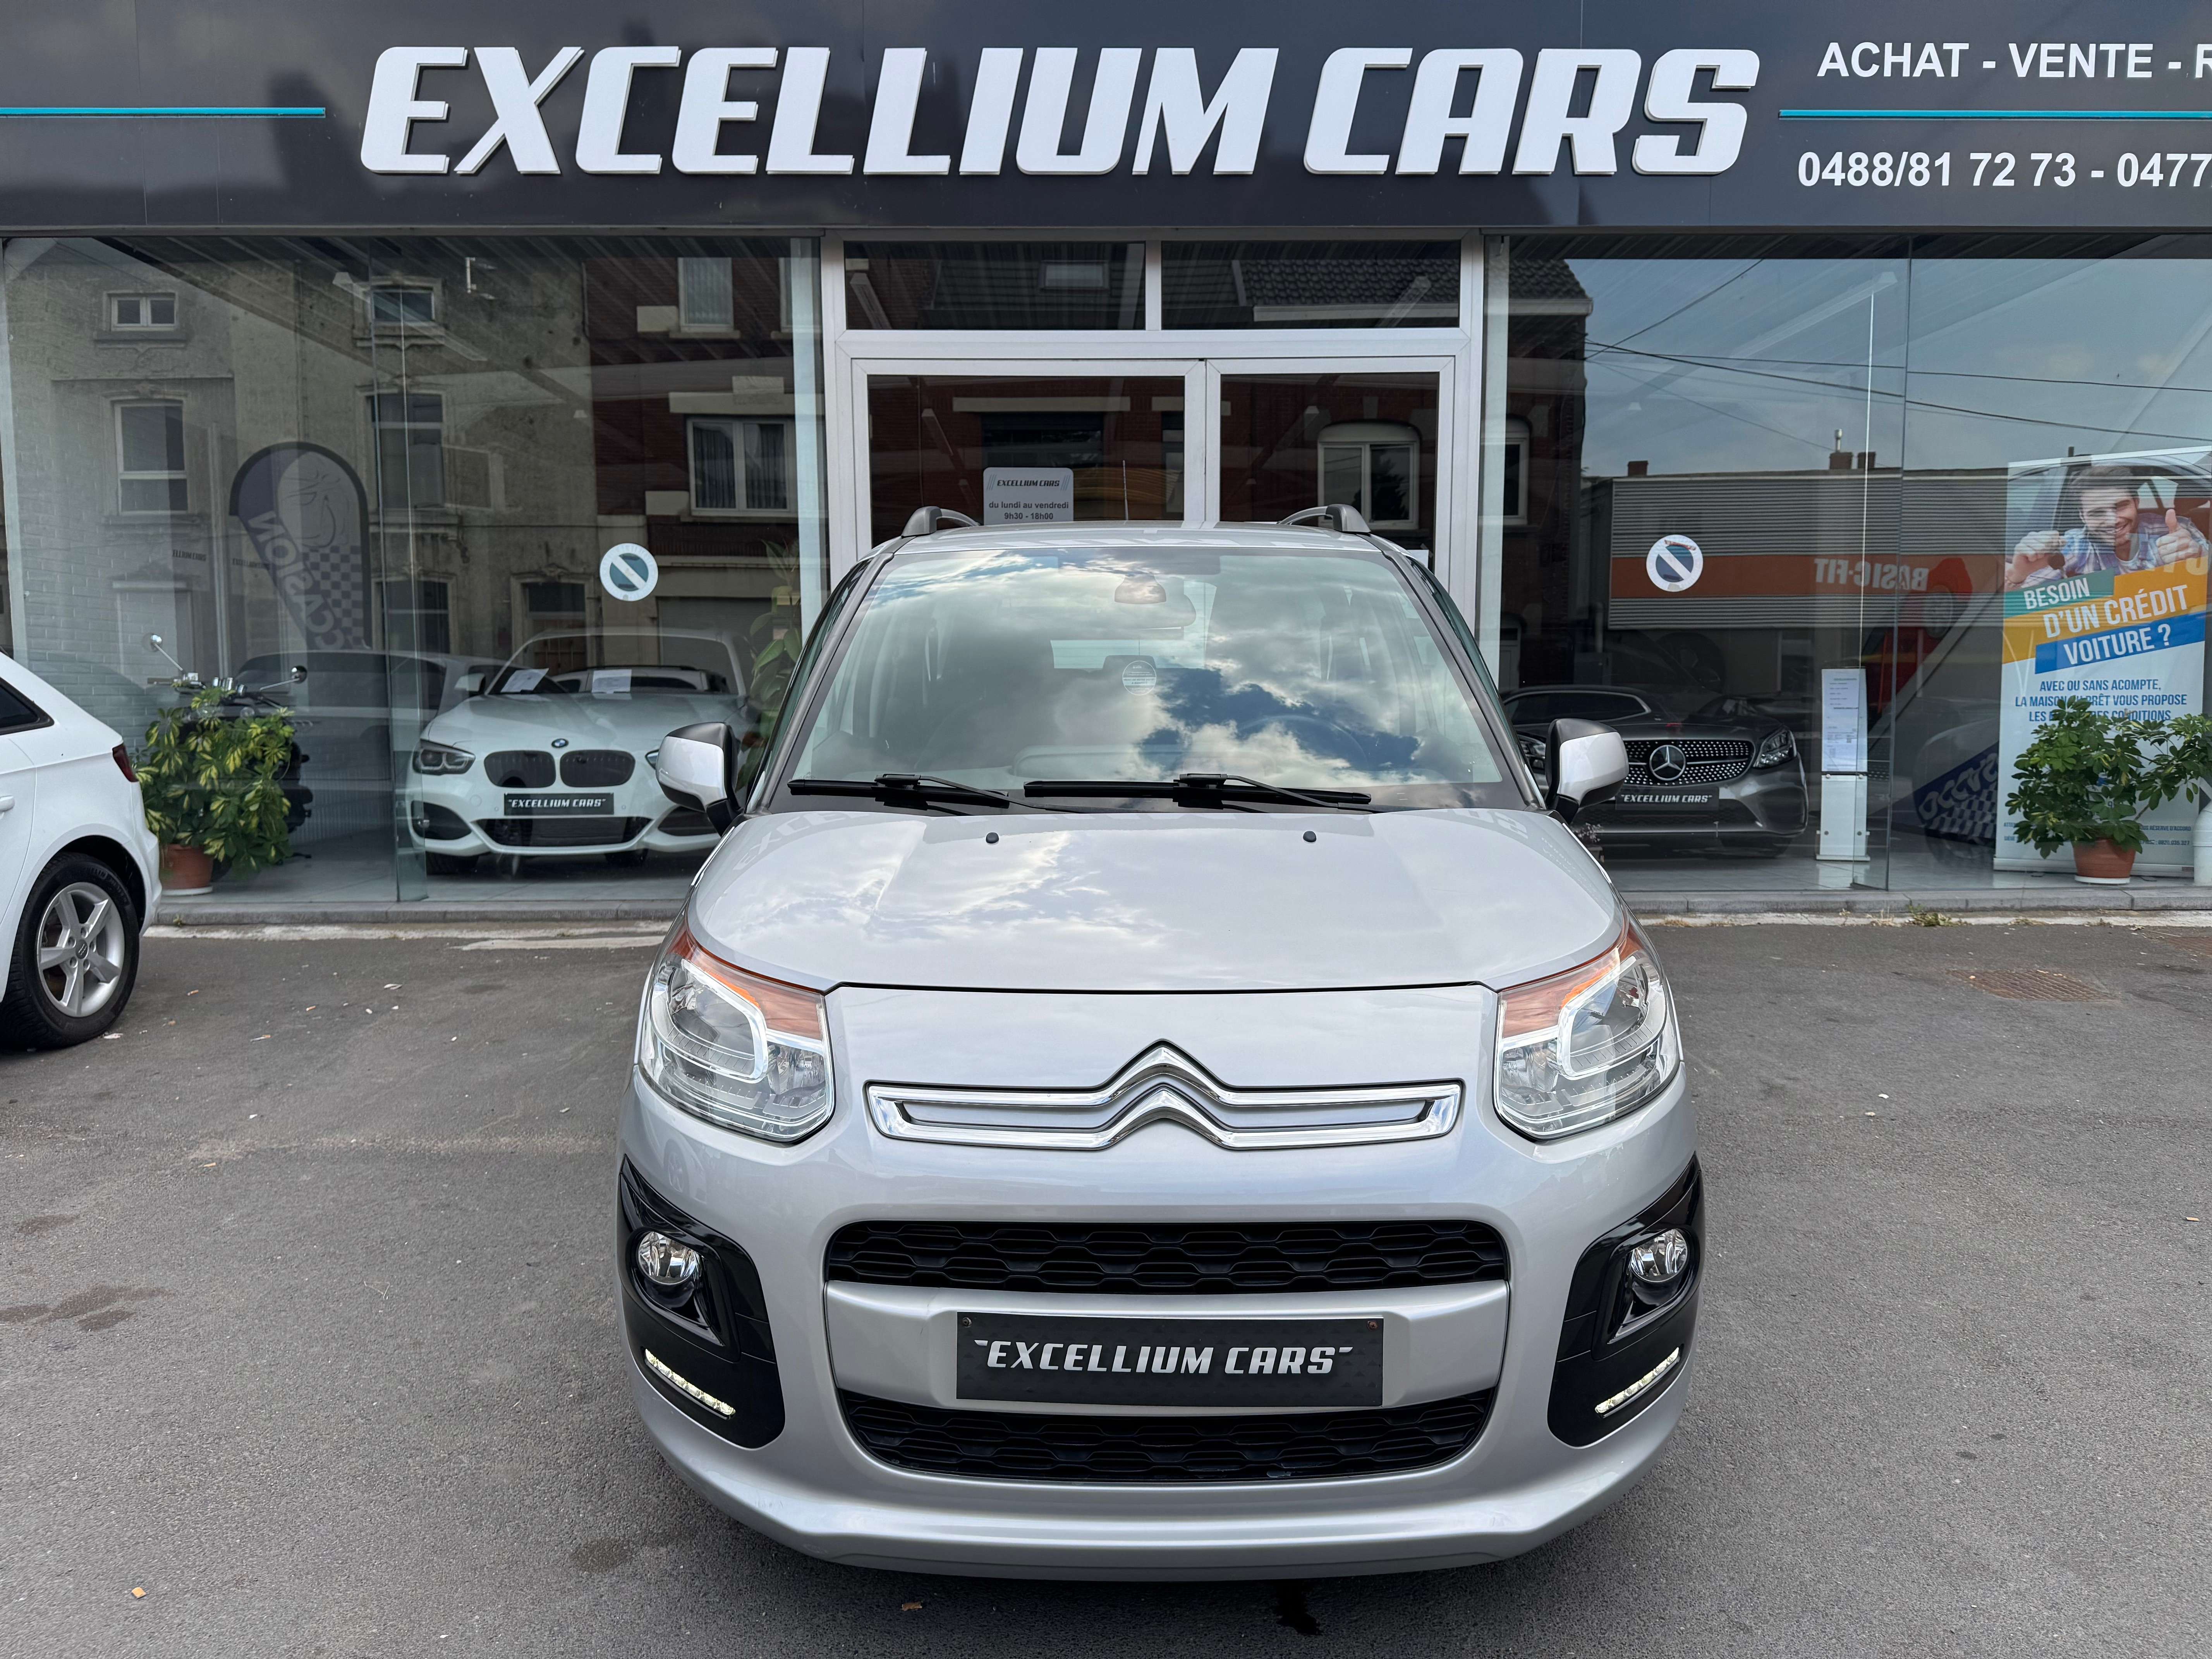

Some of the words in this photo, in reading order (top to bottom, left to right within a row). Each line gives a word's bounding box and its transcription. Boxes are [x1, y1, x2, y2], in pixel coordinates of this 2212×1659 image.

[1817, 42, 1969, 77] ACHAT
[2009, 43, 2154, 78] VENTE
[360, 46, 1279, 175] EXCELLIUM
[1304, 47, 1760, 175] CARS
[1798, 151, 1950, 187] 0488/81
[1970, 152, 2015, 187] 72
[2030, 152, 2076, 187] 73
[2023, 577, 2090, 610] BESOIN
[2043, 603, 2100, 638] D'UN
[2104, 585, 2188, 625] CRÉDIT
[2063, 627, 2155, 665] VOITURE
[2157, 623, 2171, 646] ?
[2015, 697, 2027, 707] LA
[2112, 695, 2138, 706] VOUS
[2141, 694, 2187, 705] PROPOSE
[2039, 681, 2065, 691] AVEC
[2067, 680, 2080, 690] OU
[2082, 680, 2109, 691] SANS
[2111, 679, 2161, 690] ACOMPTE,
[2029, 711, 2047, 721] LES
[511, 799, 570, 808] EXCELLIUM
[572, 799, 602, 807] CARS
[1624, 794, 1680, 803] EXCELLIUM
[1681, 795, 1709, 803] CARS
[986, 1341, 1214, 1374] EXCELLIUM
[1224, 1347, 1339, 1375] CARS
